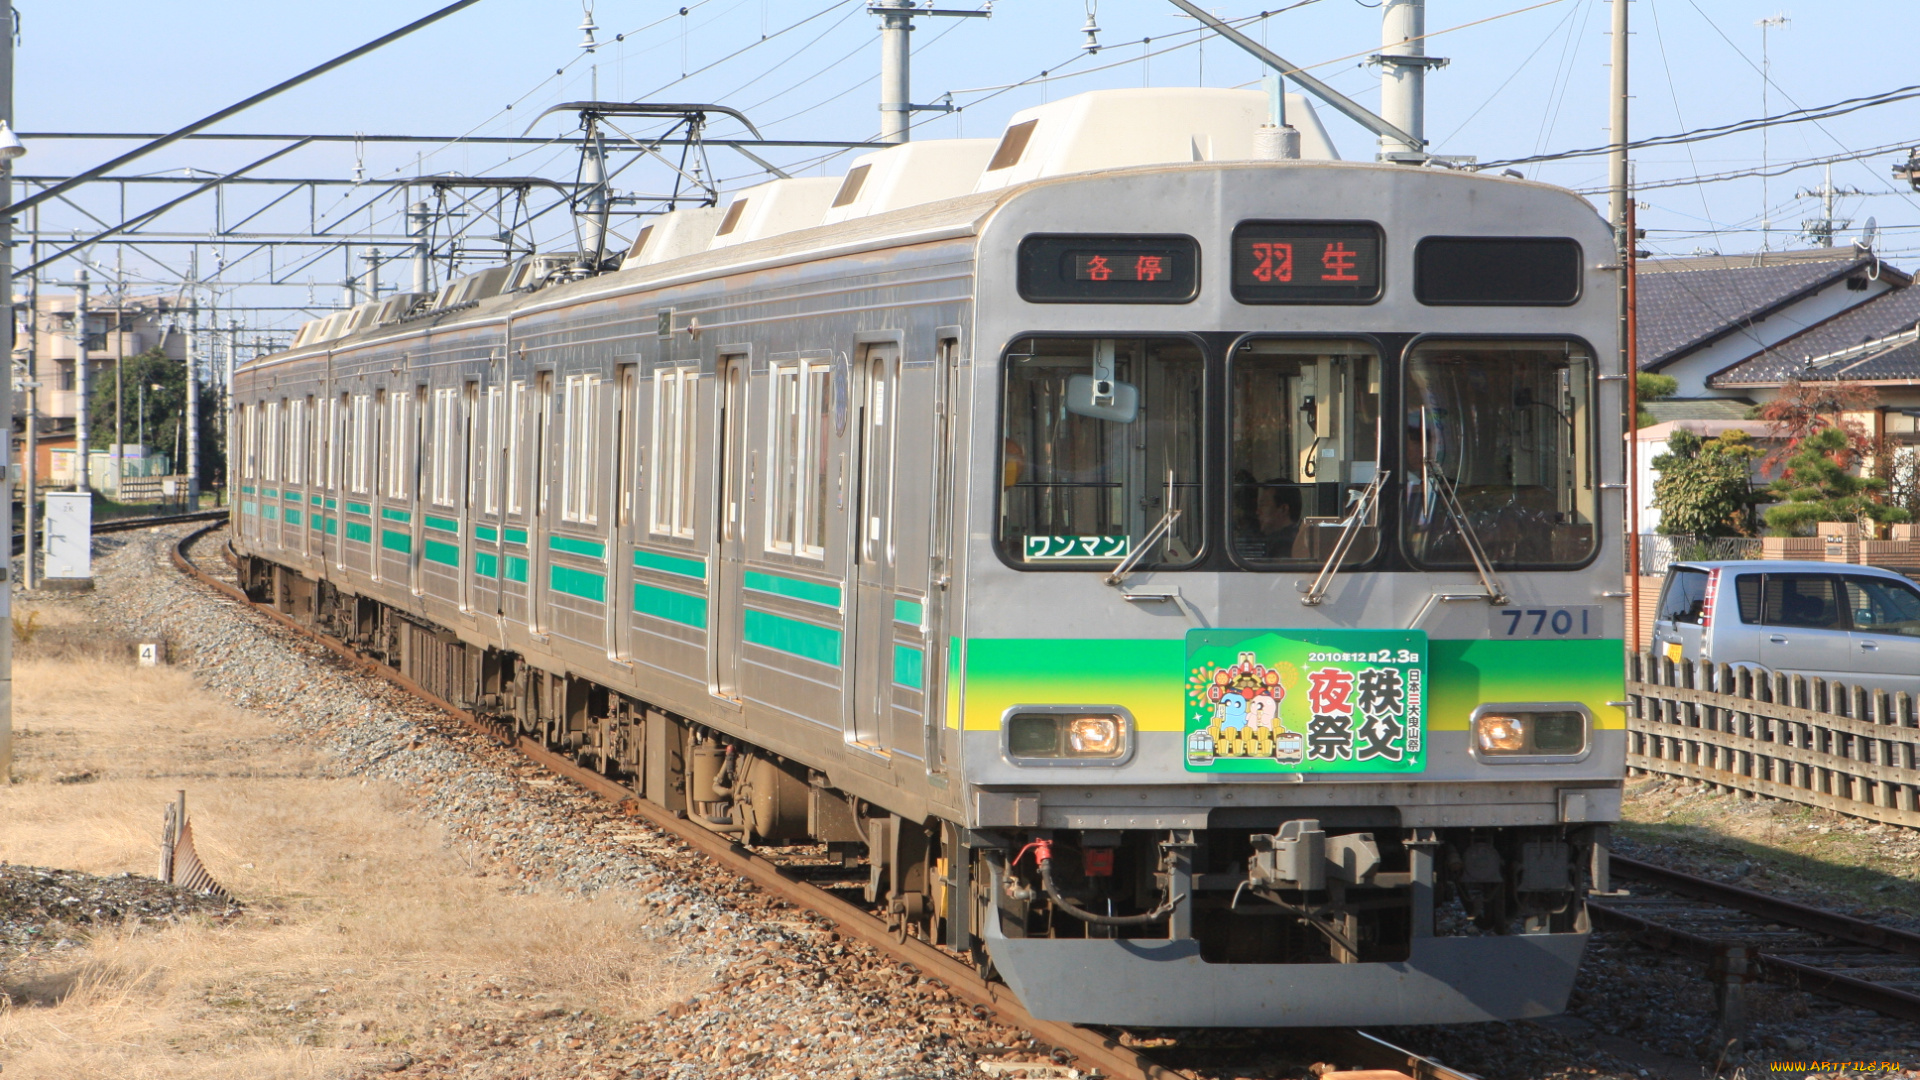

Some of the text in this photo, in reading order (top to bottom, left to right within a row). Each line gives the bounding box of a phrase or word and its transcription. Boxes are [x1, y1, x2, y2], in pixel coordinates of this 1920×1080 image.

[1086, 255, 1163, 281] 各停
[1252, 242, 1359, 282] 羽生
[1029, 536, 1125, 556] ワンマン
[1502, 609, 1588, 635] 7701
[141, 647, 152, 659] 4
